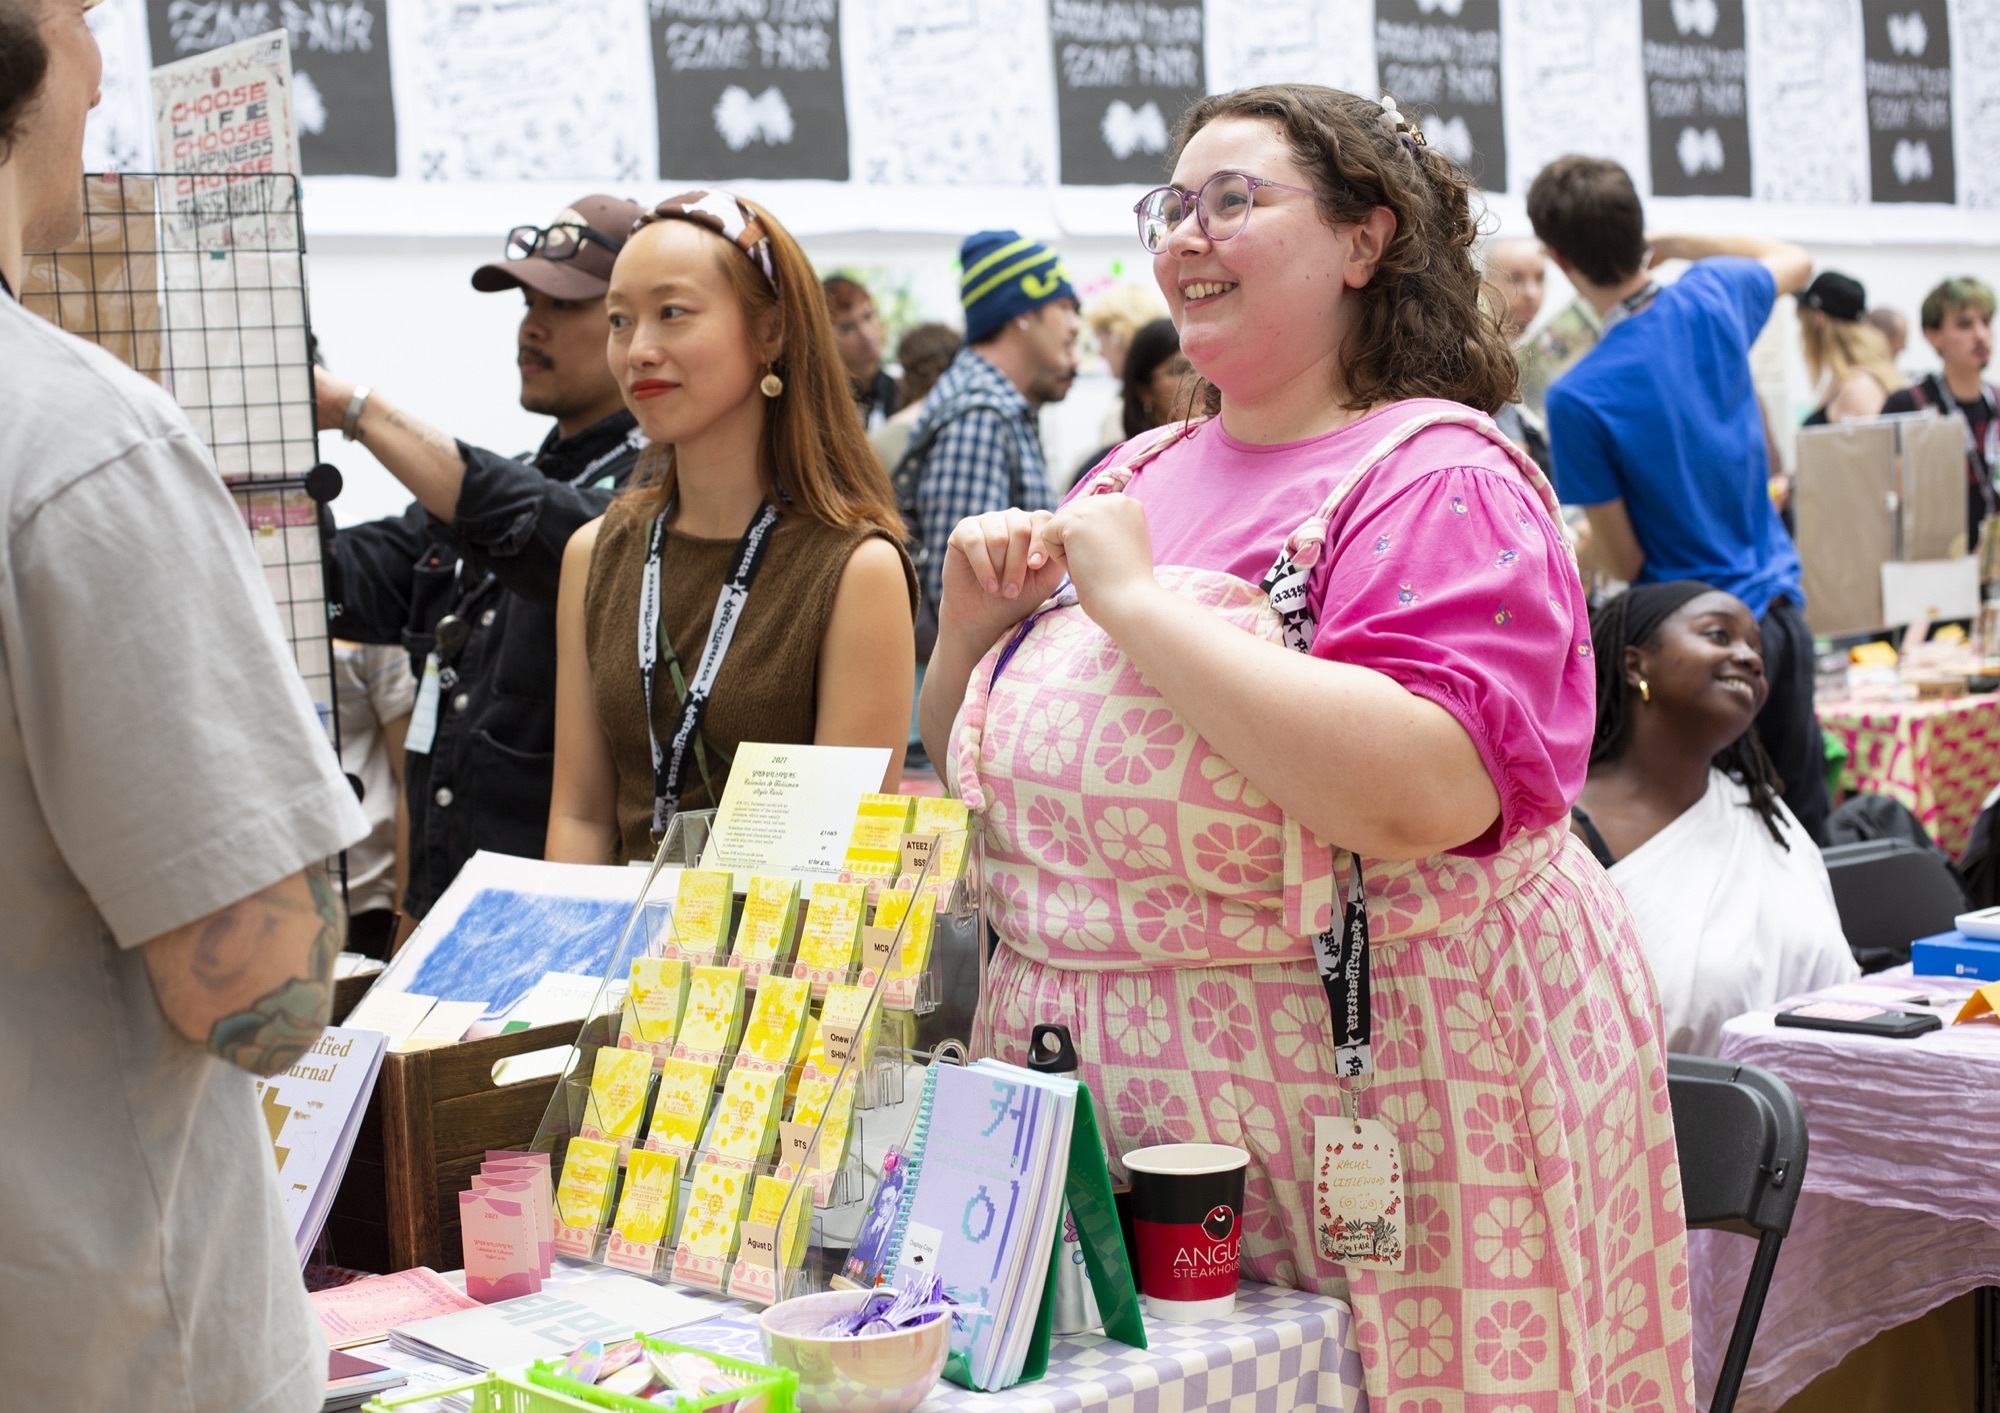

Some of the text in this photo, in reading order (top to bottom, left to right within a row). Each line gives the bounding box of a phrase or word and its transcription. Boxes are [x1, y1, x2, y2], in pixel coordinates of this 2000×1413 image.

[170, 81, 268, 124] CHOOSE
[173, 100, 269, 140] LIFE
[174, 118, 271, 159] CHOOSE
[174, 136, 274, 177] HAPPINESS
[176, 157, 273, 196] CHOOSE
[906, 841, 928, 851] ATEEZ
[874, 943, 890, 953] MCR
[306, 1035, 354, 1058] ified
[830, 1033, 849, 1044] Onew
[264, 1063, 338, 1083] urnal
[793, 1139, 807, 1150] BTS
[1336, 1159, 1372, 1170] RACHEL
[1333, 1175, 1385, 1188] LITTLEWOOD
[484, 1211, 499, 1220] 2027
[747, 1236, 773, 1252] Agust D
[909, 1239, 934, 1254] Display Copy
[1173, 1236, 1242, 1267] ANGUS
[1353, 1241, 1370, 1252] FAIR
[1173, 1263, 1241, 1279] STEAKHOUS
